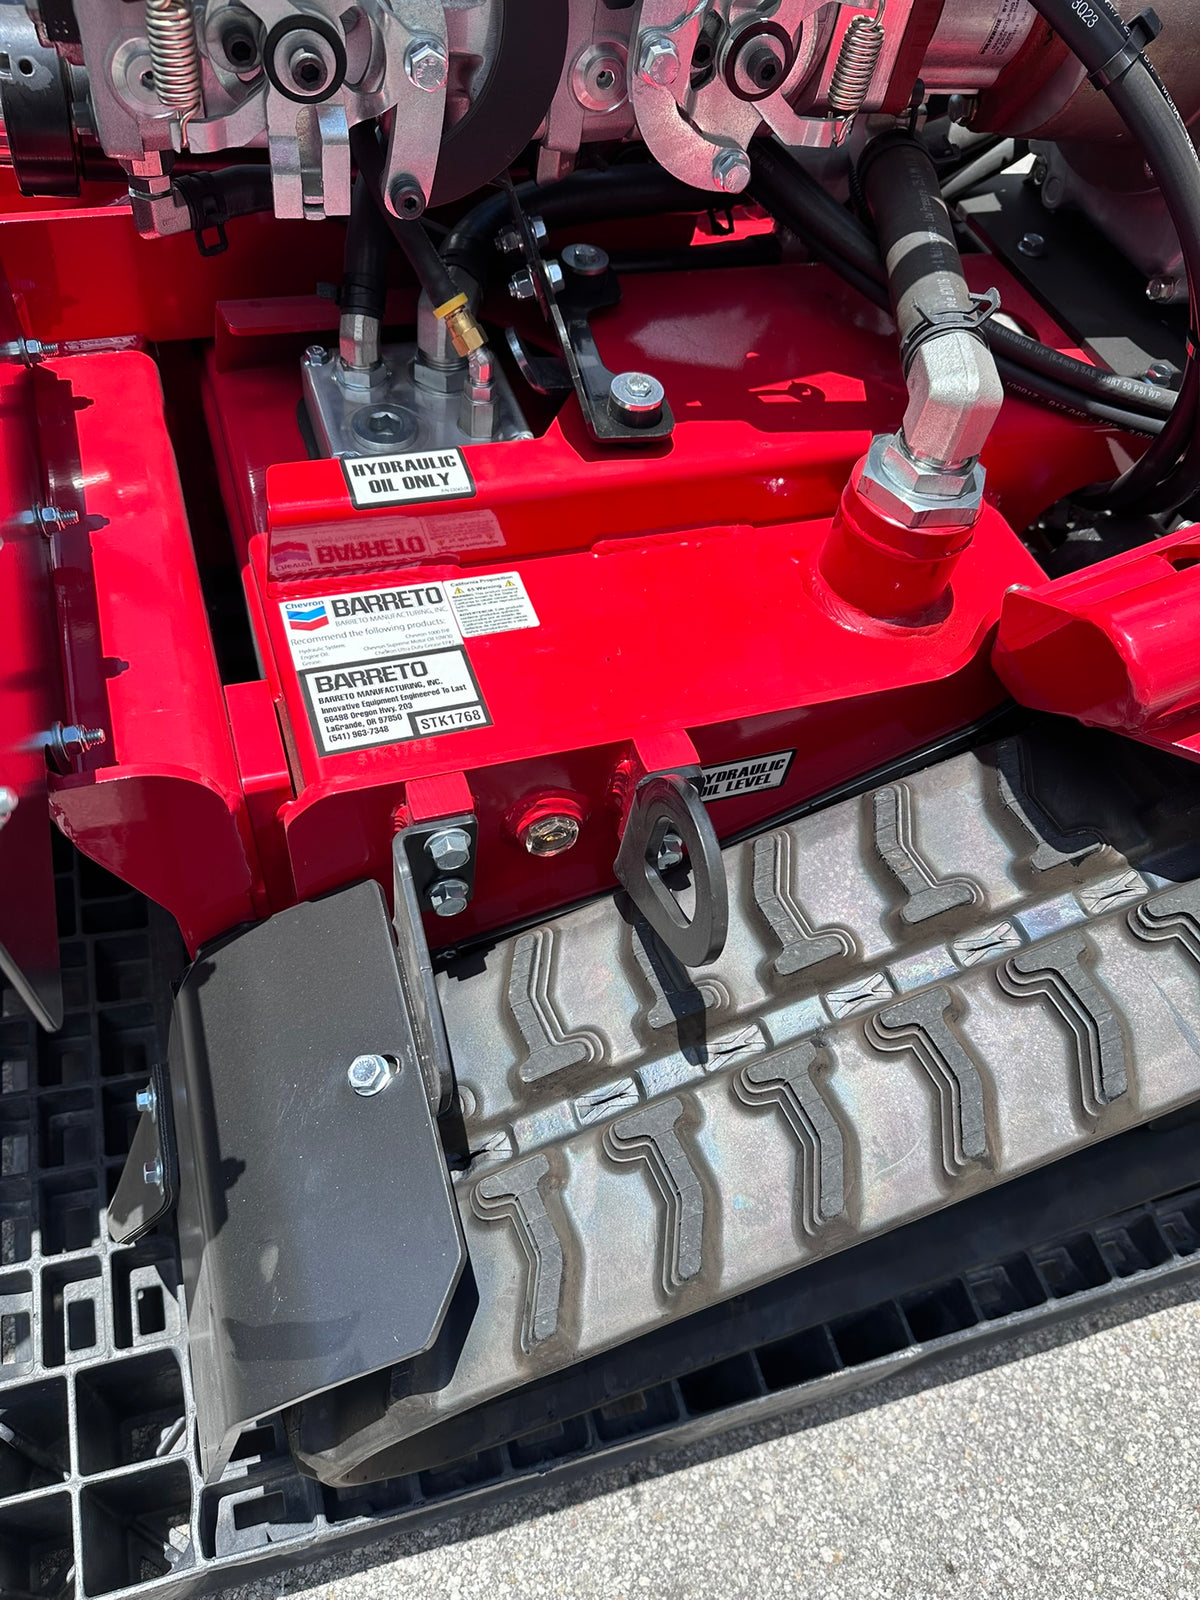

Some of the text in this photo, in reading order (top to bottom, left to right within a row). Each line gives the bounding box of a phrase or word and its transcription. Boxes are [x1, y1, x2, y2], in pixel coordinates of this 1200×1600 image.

[1133, 383, 1147, 395] PSI
[351, 455, 457, 477] HYDRAULIC
[368, 478, 400, 493] OIL
[402, 472, 450, 490] ONLY
[284, 600, 325, 610] Chevron
[331, 586, 444, 618] BARRETO
[291, 631, 348, 646] Recommend
[349, 627, 364, 639] the
[364, 621, 406, 636] following
[406, 618, 445, 631] products:
[335, 615, 369, 627] BARRETO
[314, 660, 429, 693] BARRETO
[318, 678, 443, 705] BARRETO MANUFACTURING, INC.
[321, 683, 467, 714] Innovative Equipment Engineered To Last
[323, 702, 414, 724] 66498 Oregon Hwy. 203
[326, 713, 403, 734] LaGrande, OR 97850
[329, 709, 482, 743] (541) 963-7348 STK1768
[704, 759, 786, 785] YDRAULIC
[725, 773, 772, 793] LEVEL
